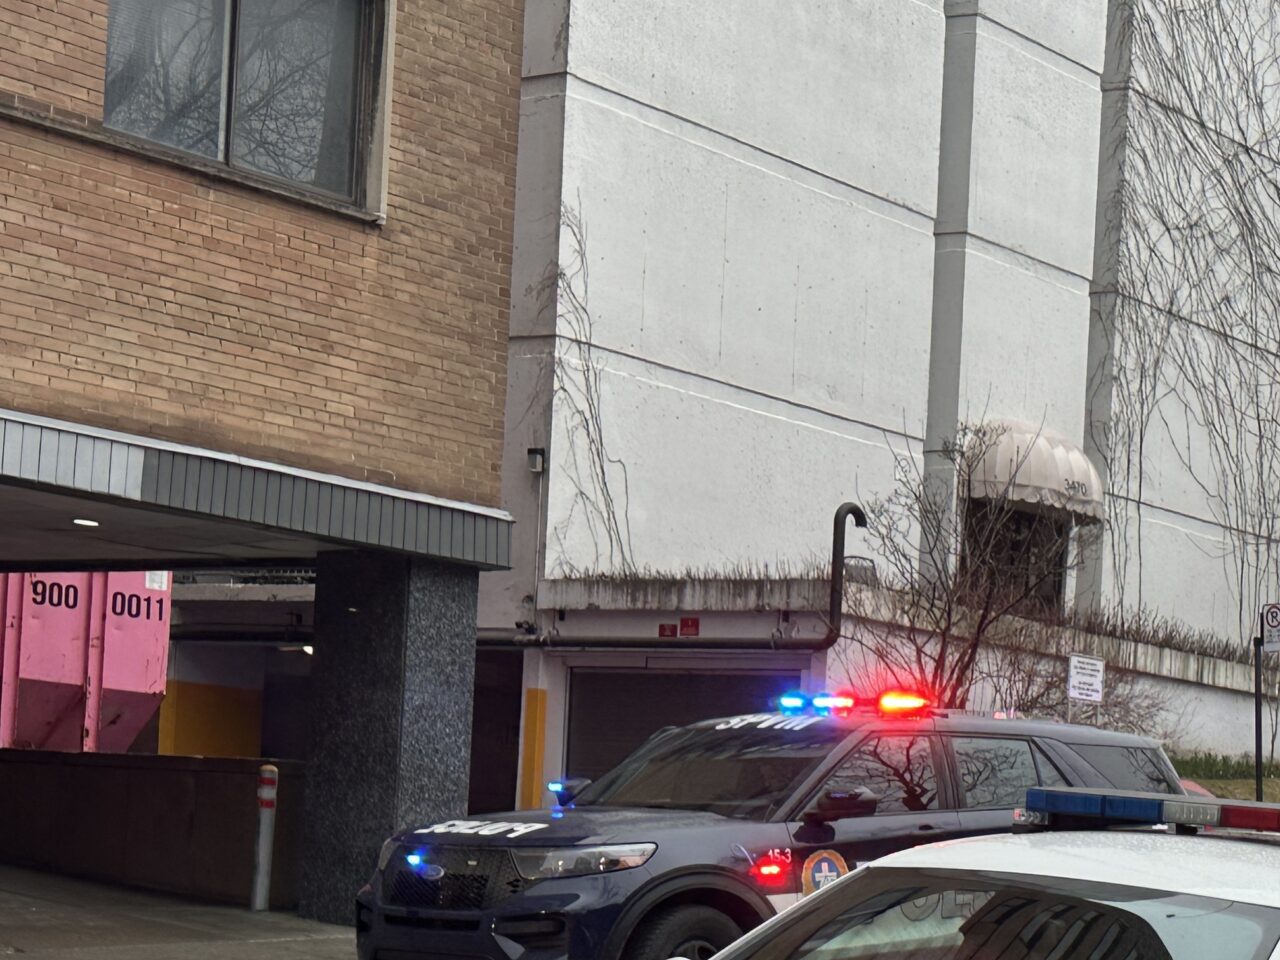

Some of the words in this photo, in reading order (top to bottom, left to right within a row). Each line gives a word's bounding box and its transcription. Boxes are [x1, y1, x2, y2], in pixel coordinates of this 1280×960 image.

[32, 580, 79, 609] 900
[111, 591, 164, 621] 0011
[768, 848, 792, 863] 15-3
